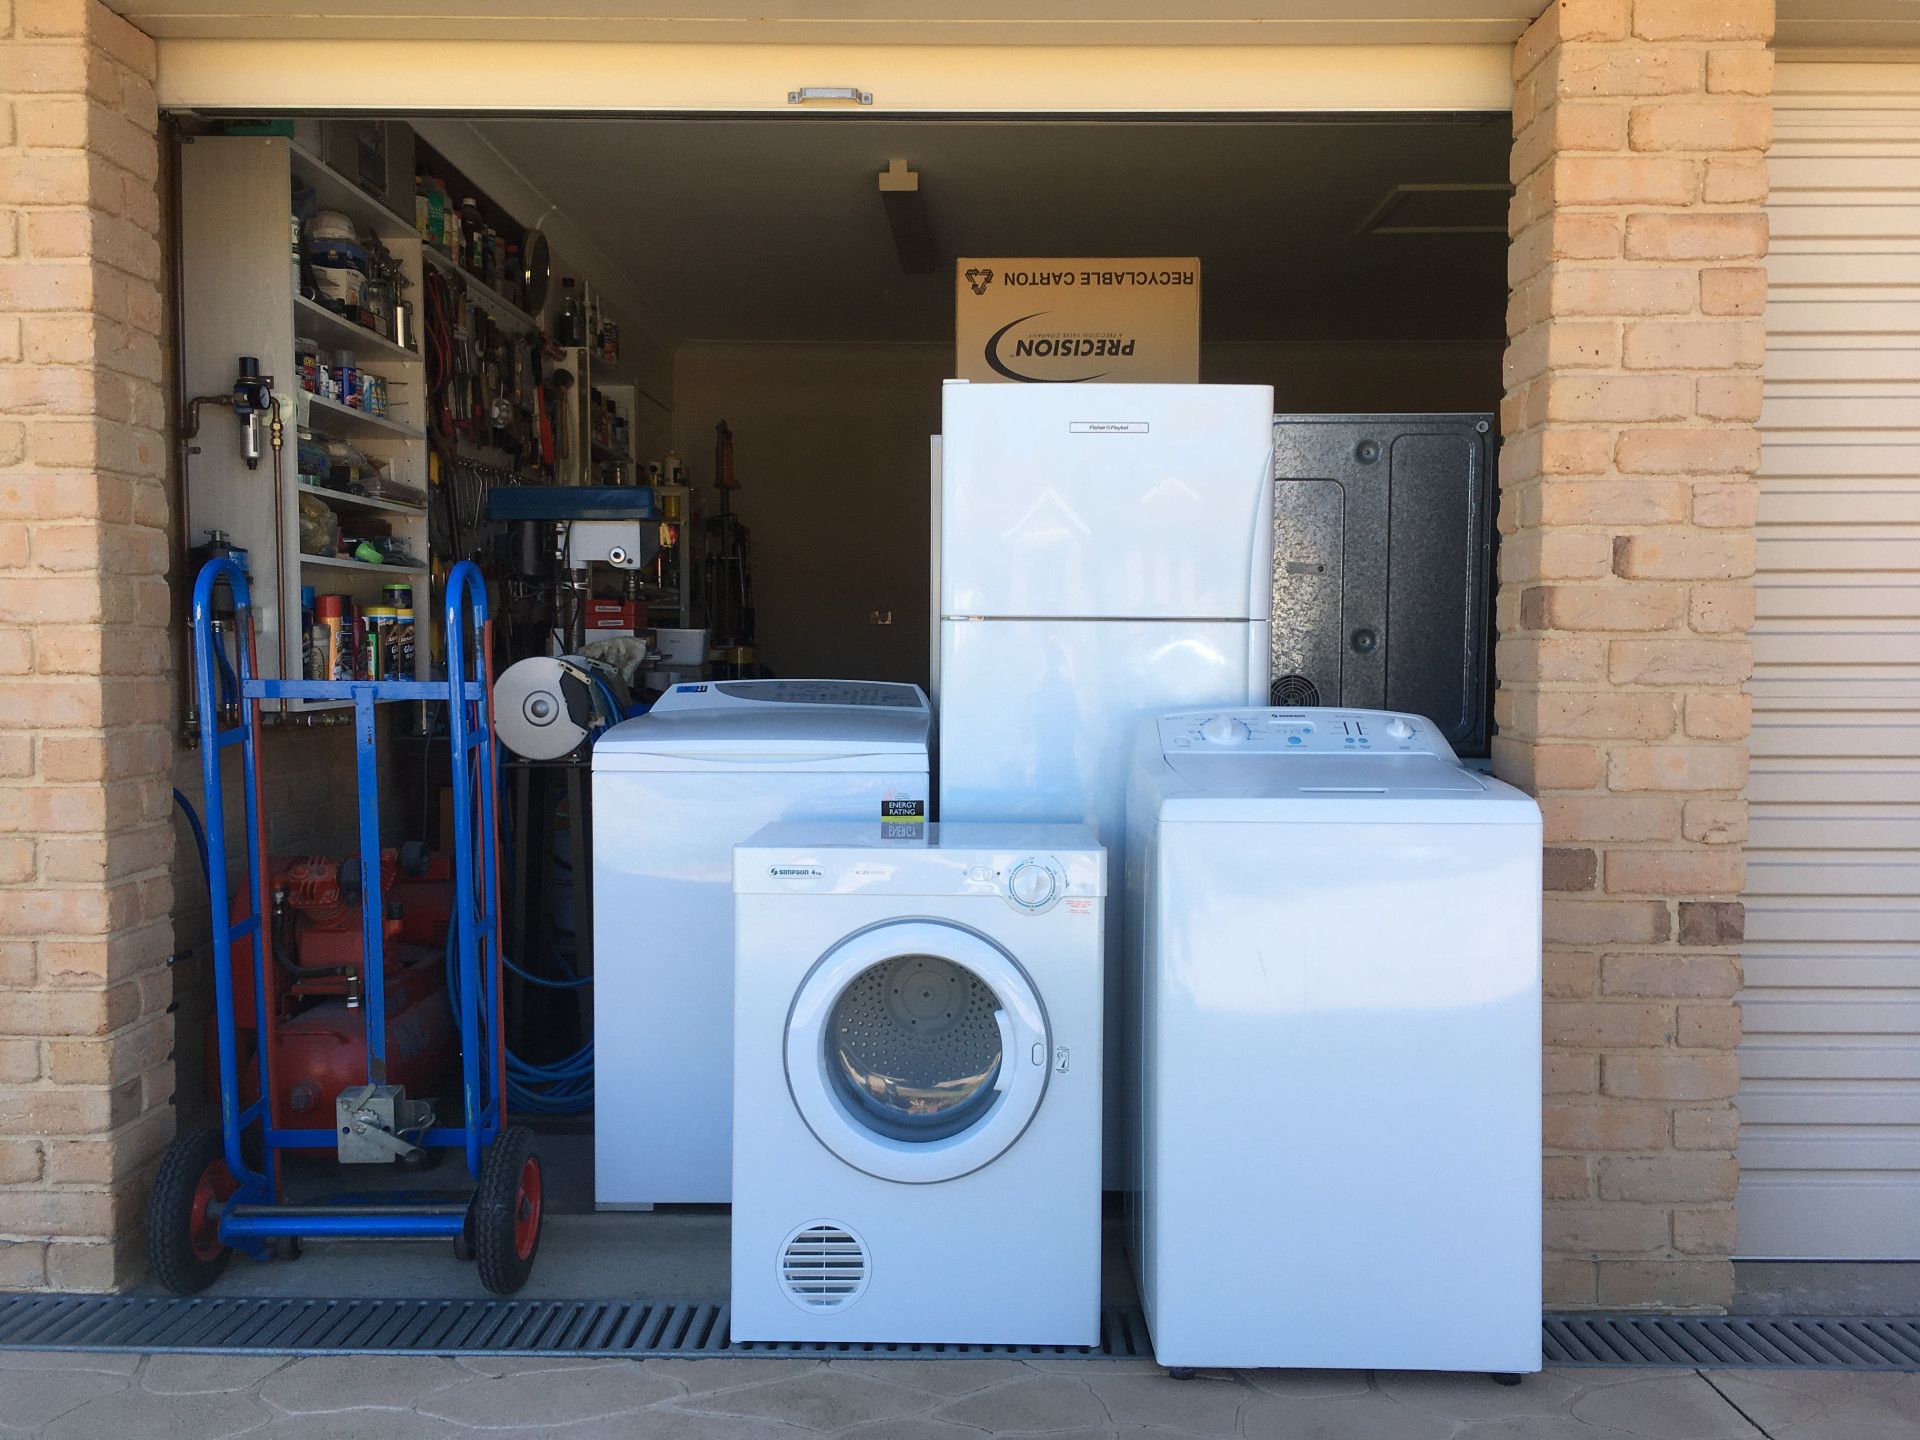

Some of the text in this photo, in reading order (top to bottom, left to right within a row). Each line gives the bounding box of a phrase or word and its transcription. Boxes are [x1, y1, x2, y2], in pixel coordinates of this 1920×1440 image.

[1004, 271, 1194, 286] RECYCLABLE CARTON
[1015, 339, 1136, 357] PRECISION
[888, 801, 917, 809] ENERGY
[888, 808, 916, 816] RATING
